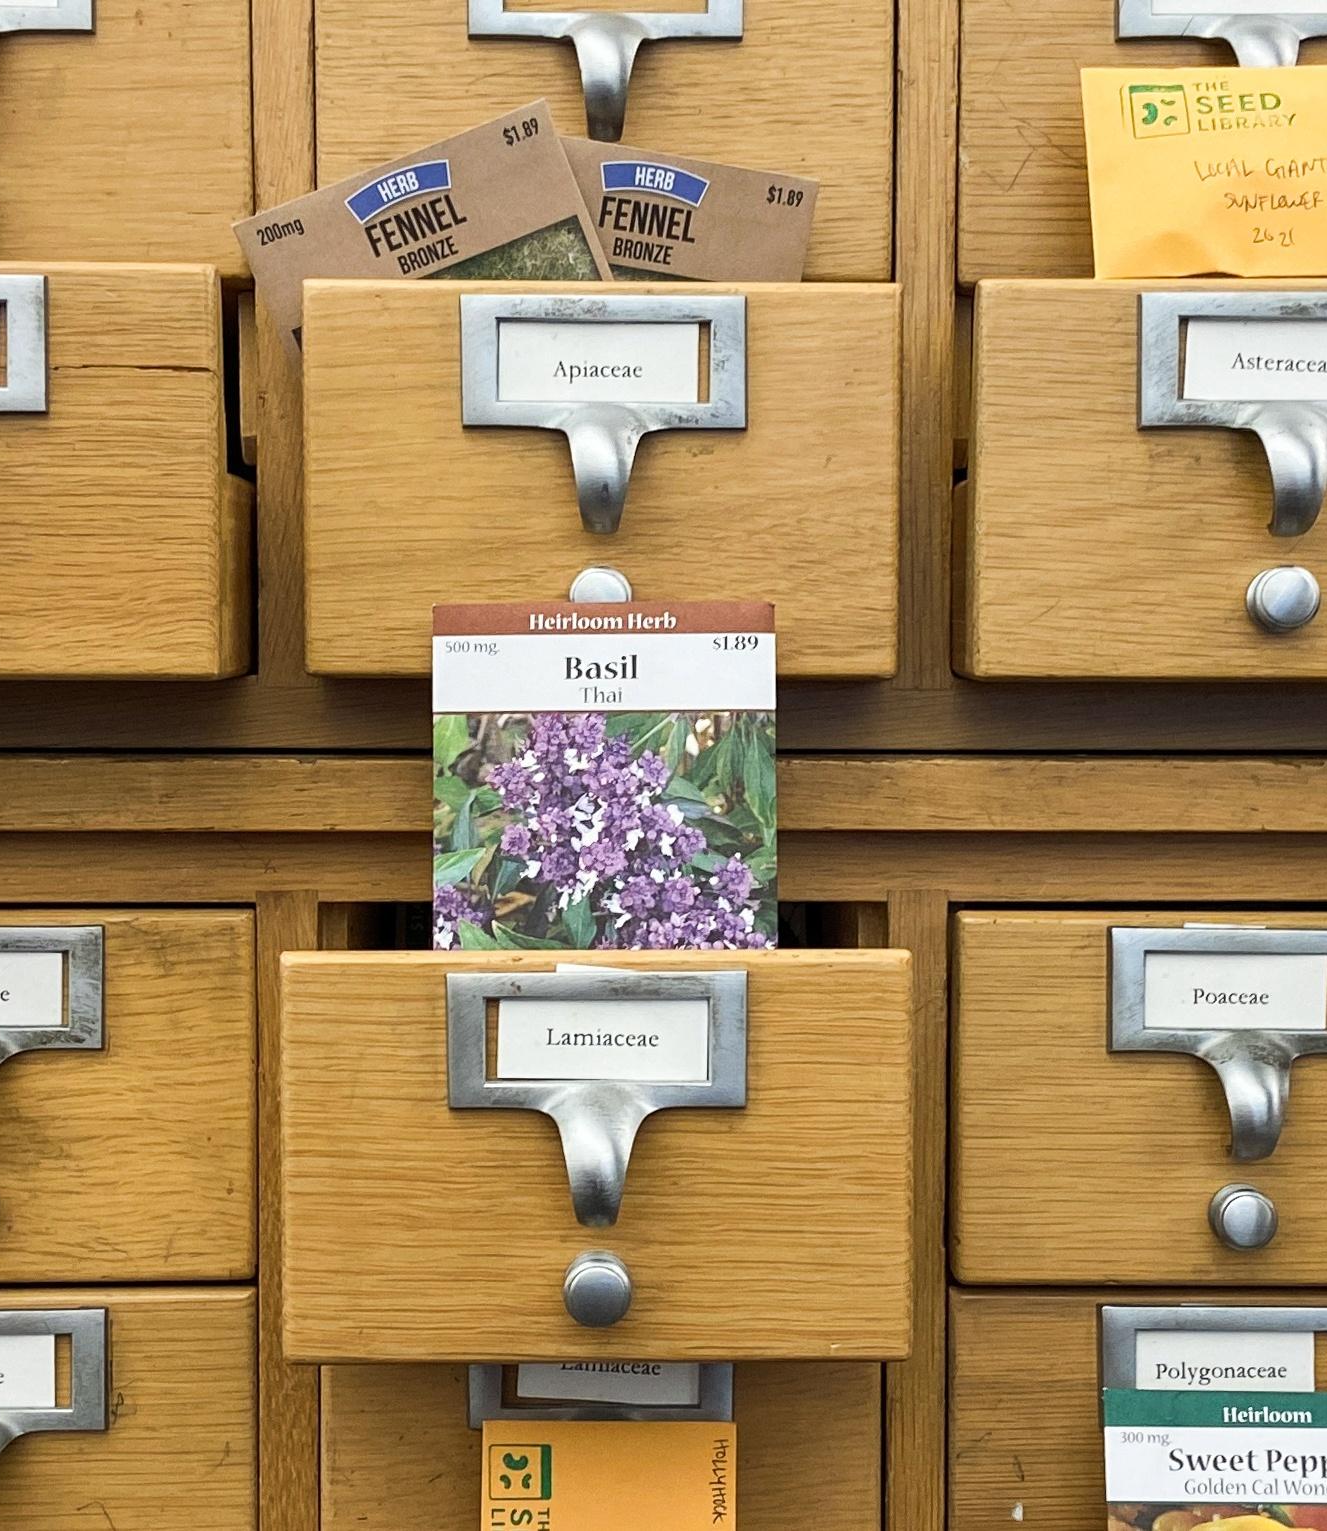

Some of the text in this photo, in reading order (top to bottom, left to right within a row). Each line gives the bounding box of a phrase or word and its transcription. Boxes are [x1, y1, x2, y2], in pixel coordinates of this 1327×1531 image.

[1192, 81, 1229, 92] THE
[1196, 93, 1281, 115] SEED
[502, 118, 540, 147] $1.89
[1198, 113, 1297, 132] LIBRARY
[376, 171, 420, 203] HERB
[633, 166, 676, 192] HERB
[766, 184, 804, 208] $1.89
[364, 194, 468, 259] FENNEL
[598, 195, 696, 244] FENNEL
[256, 218, 305, 247] 200mg
[396, 235, 460, 276] BRONZE
[612, 237, 674, 266] BRONZE
[553, 360, 643, 385] Apiaceae
[529, 613, 677, 631] Heirloom Herb
[445, 640, 471, 654] 500
[712, 635, 760, 652] $1.89
[565, 654, 639, 681] Basil
[580, 687, 623, 704] Thai
[1192, 987, 1270, 1006] Poaceae
[546, 1027, 660, 1048] Lamiaceae
[1155, 1361, 1288, 1386] Polygonaceae
[1223, 1406, 1313, 1425] Heirloom
[1120, 1430, 1145, 1445] 300
[1168, 1448, 1258, 1474] Sweet
[1184, 1478, 1248, 1497] Golden
[1252, 1478, 1280, 1497] Cal
